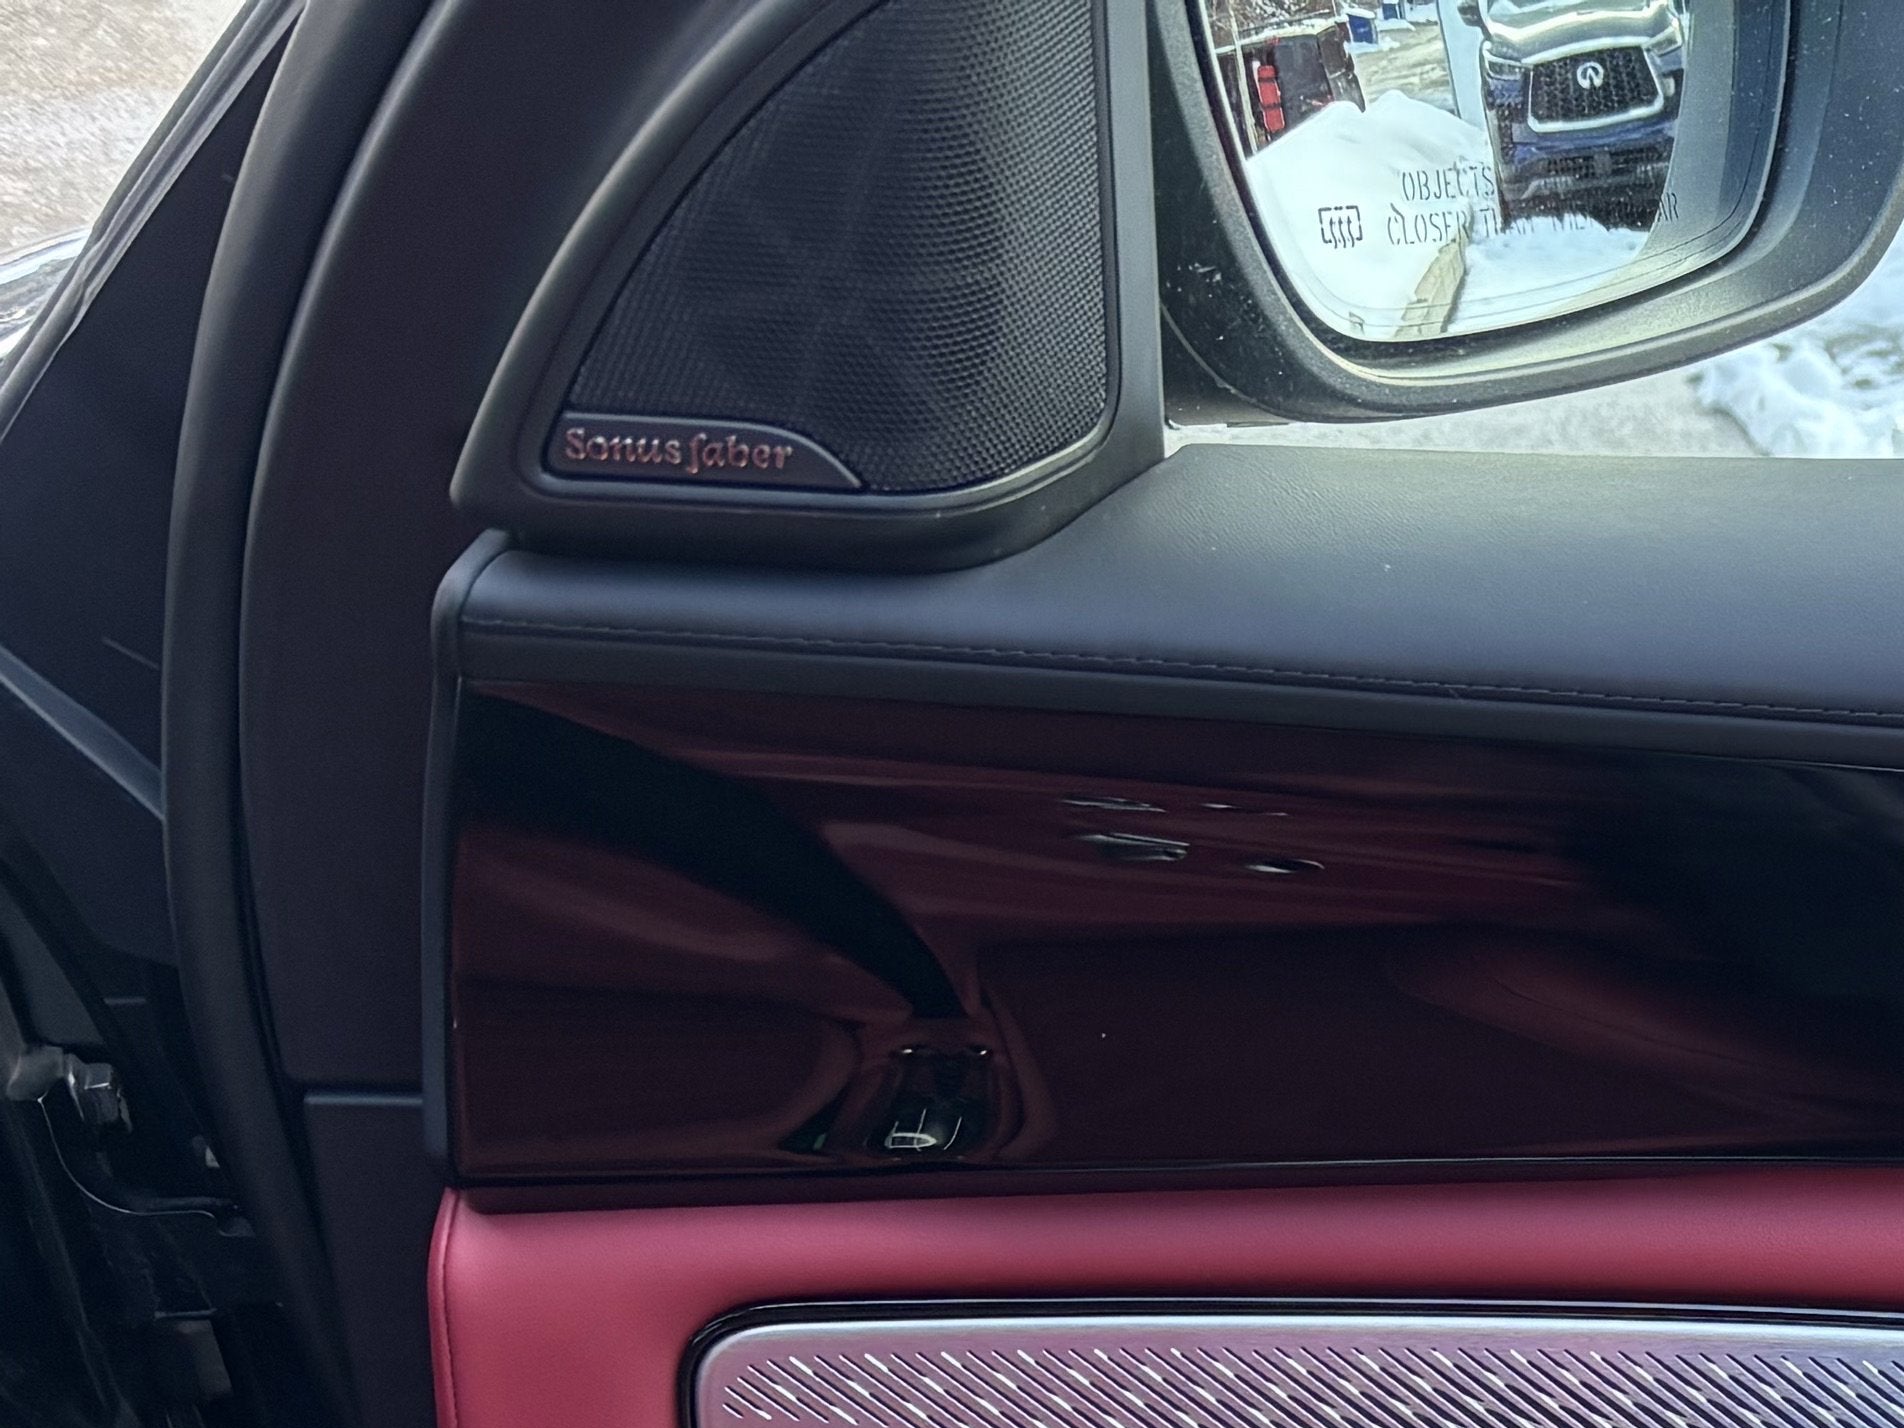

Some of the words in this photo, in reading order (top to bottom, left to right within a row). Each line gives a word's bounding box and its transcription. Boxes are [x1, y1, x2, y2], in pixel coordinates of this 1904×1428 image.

[1401, 165, 1496, 201] OBJECTS
[1387, 209, 1472, 245] CLOSER
[565, 427, 682, 465] Sonus
[686, 432, 793, 475] faber
